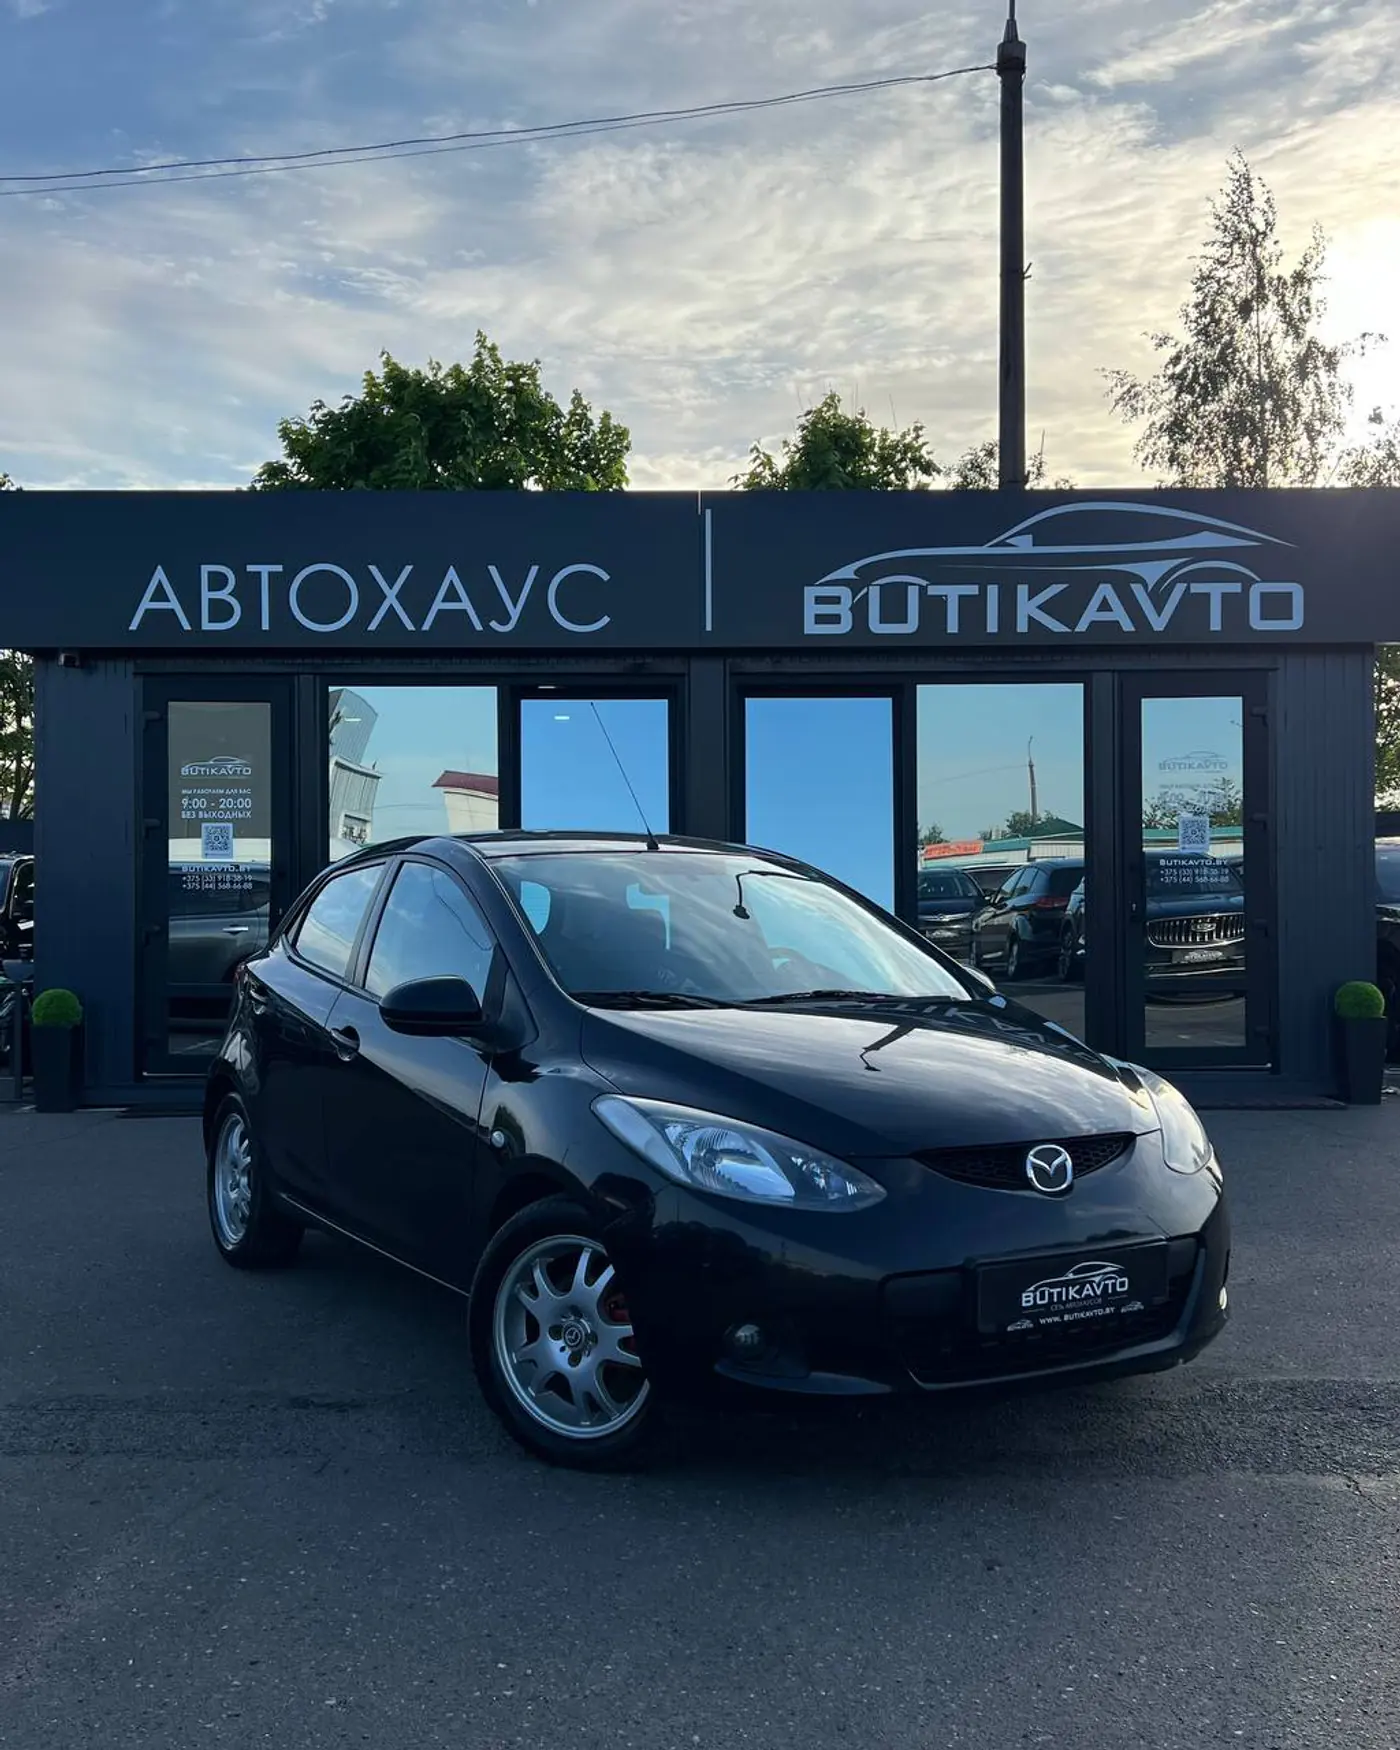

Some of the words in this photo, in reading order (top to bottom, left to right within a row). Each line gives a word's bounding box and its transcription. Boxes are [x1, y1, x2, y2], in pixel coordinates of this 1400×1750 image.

[128, 563, 611, 633] АВТОХАУС
[804, 581, 1304, 635] BUTIKAVTO
[181, 766, 252, 776] BUTIKAVTO
[181, 798, 207, 809] 9:00
[219, 798, 252, 809] 20:00
[181, 810, 196, 819] БЕЗ
[198, 810, 252, 819] ВЫХОДНЫХ
[1021, 1277, 1129, 1307] BUTIKAVTO
